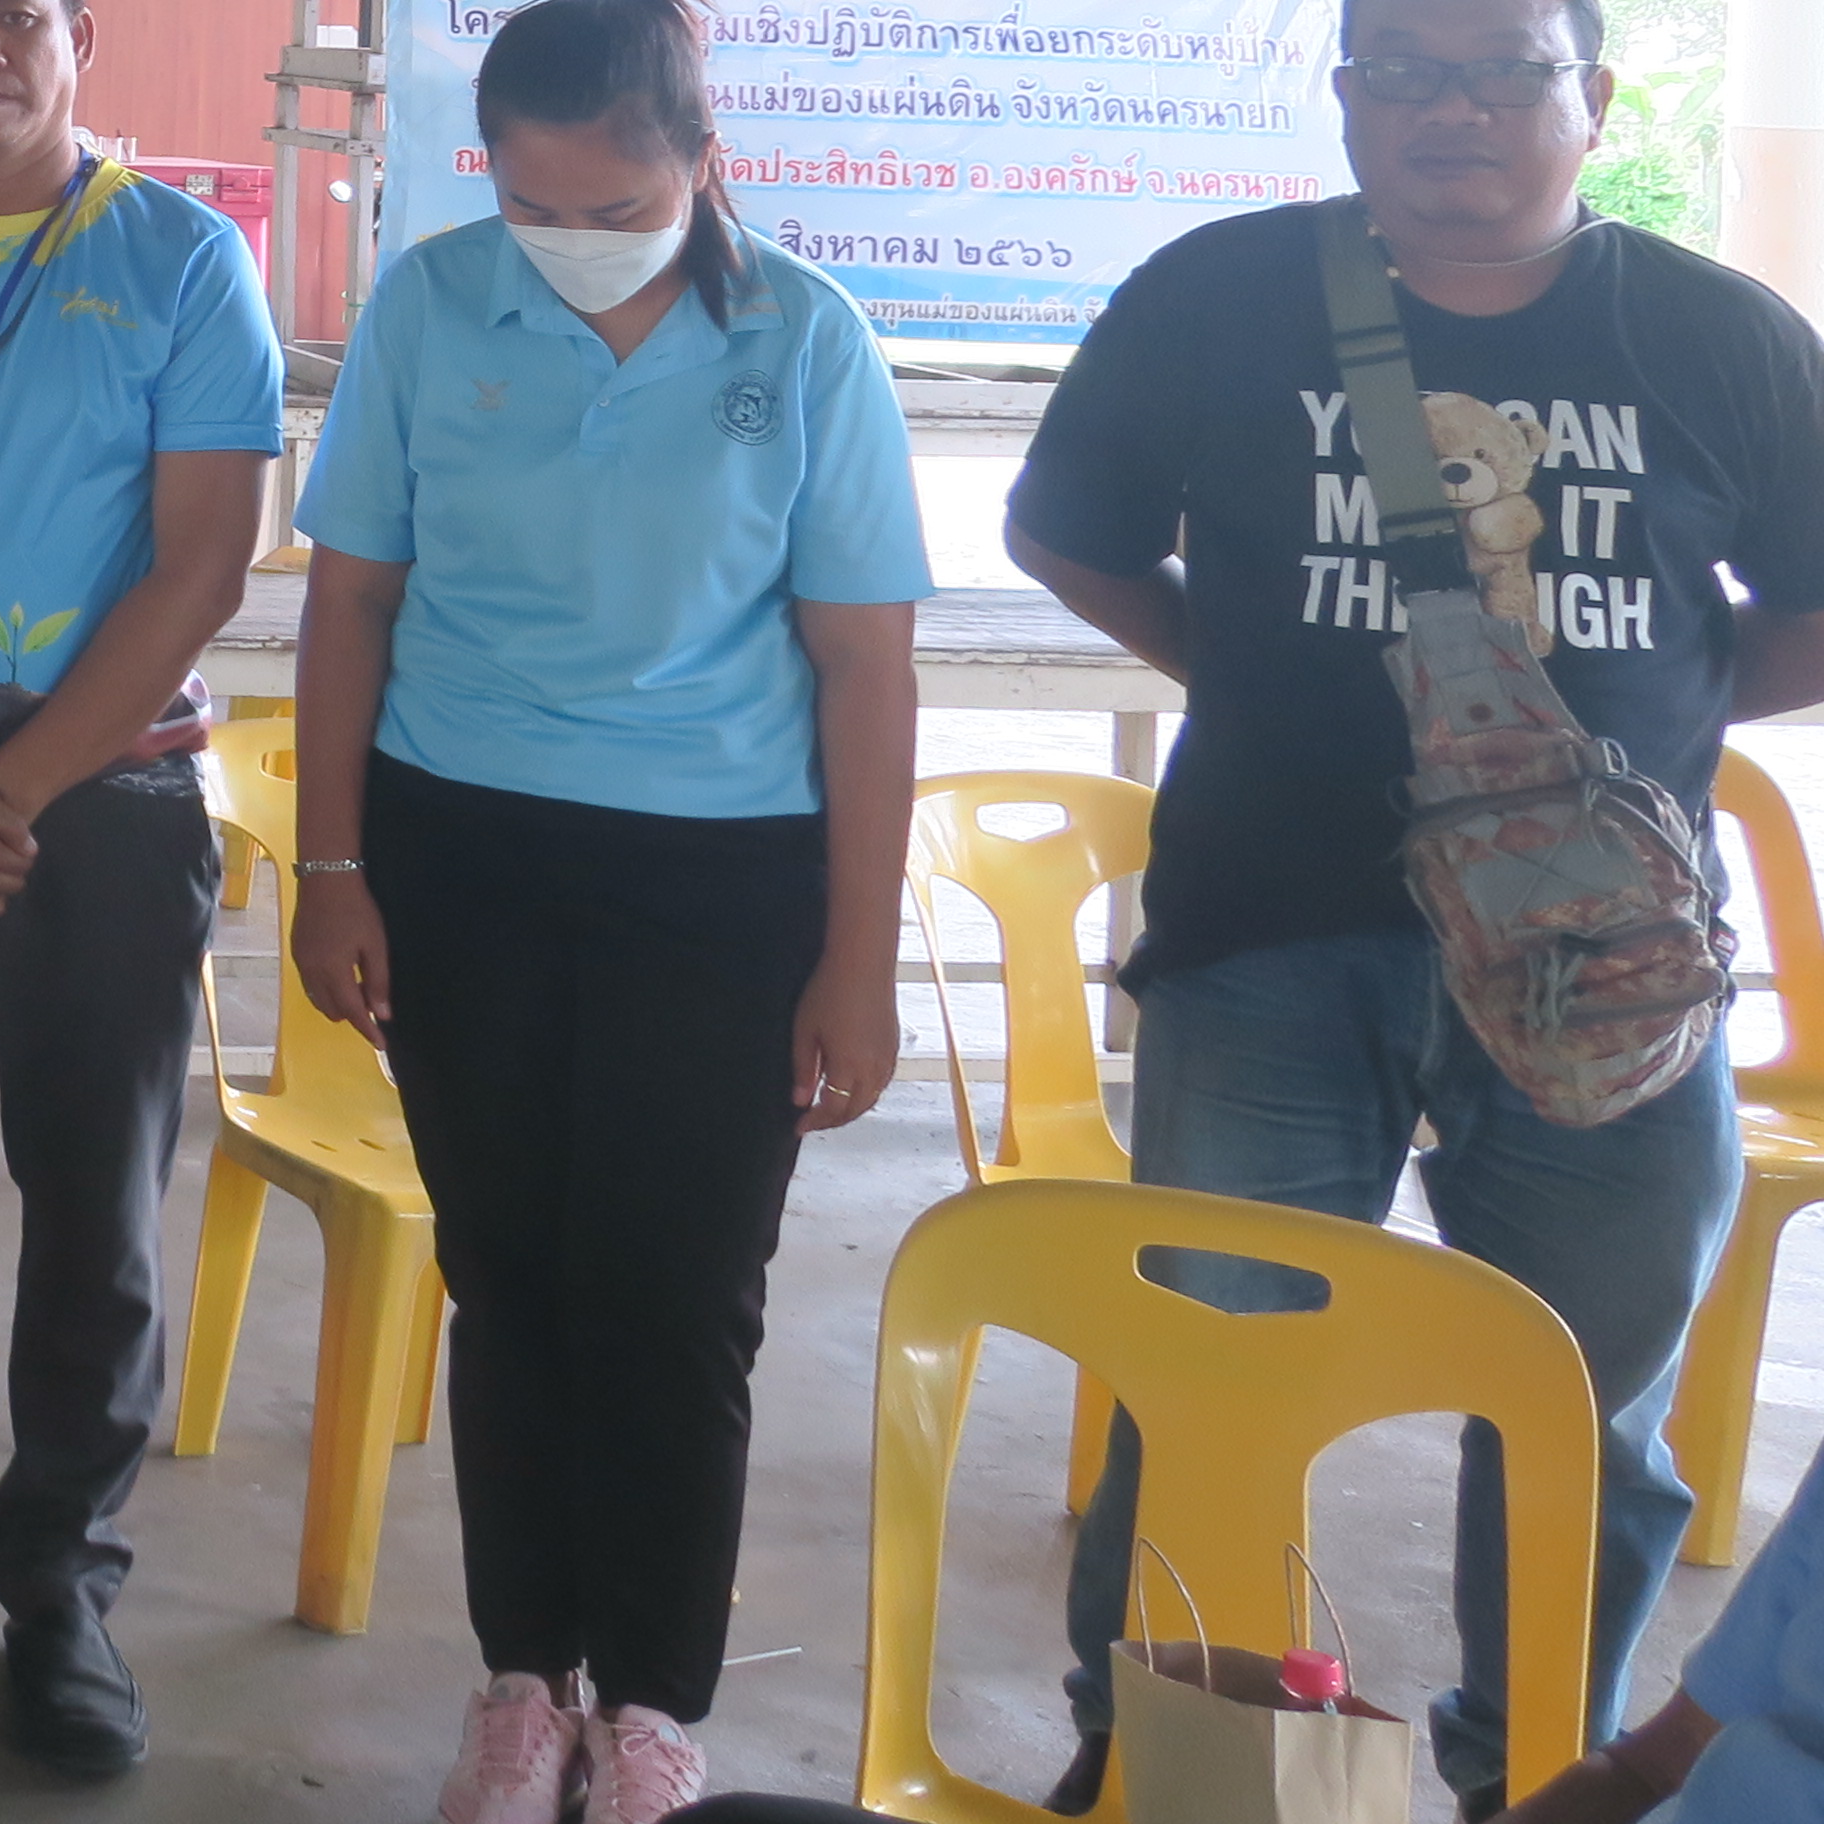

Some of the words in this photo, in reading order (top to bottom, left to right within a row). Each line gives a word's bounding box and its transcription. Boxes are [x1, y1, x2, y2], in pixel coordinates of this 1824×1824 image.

[706, 71, 1001, 119] นแม่ของแผ่นดิน
[1011, 78, 1291, 130] จังหวัดนครนายก
[969, 152, 1139, 194] อ.องครักษ์
[954, 237, 1073, 268] ๒๕๖๖
[1560, 484, 1633, 560] IT
